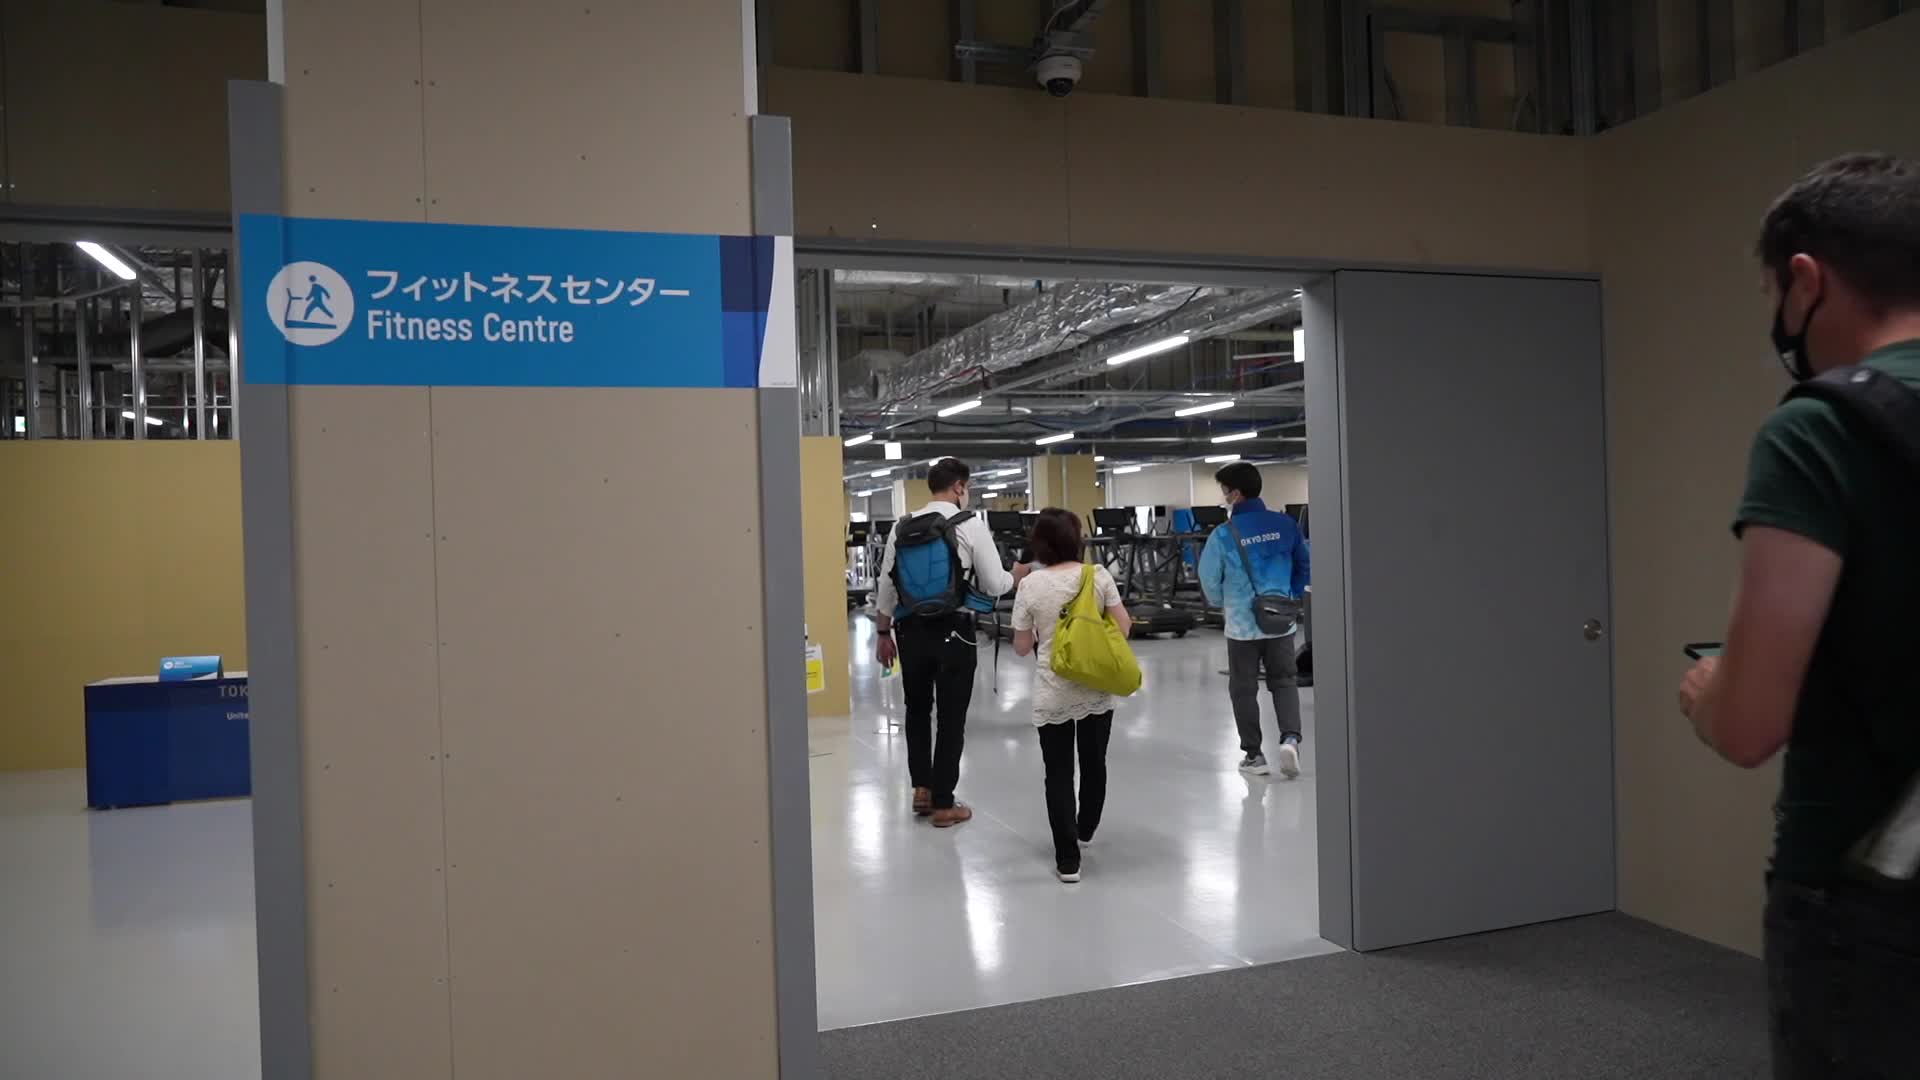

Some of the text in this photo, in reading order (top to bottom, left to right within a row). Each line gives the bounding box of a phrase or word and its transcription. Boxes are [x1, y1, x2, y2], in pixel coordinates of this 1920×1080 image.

[368, 270, 690, 306] フィットネスセンター
[367, 310, 574, 343] Fitness Centre
[1241, 533, 1280, 546] OKYO 2020
[219, 686, 248, 696] TOK
